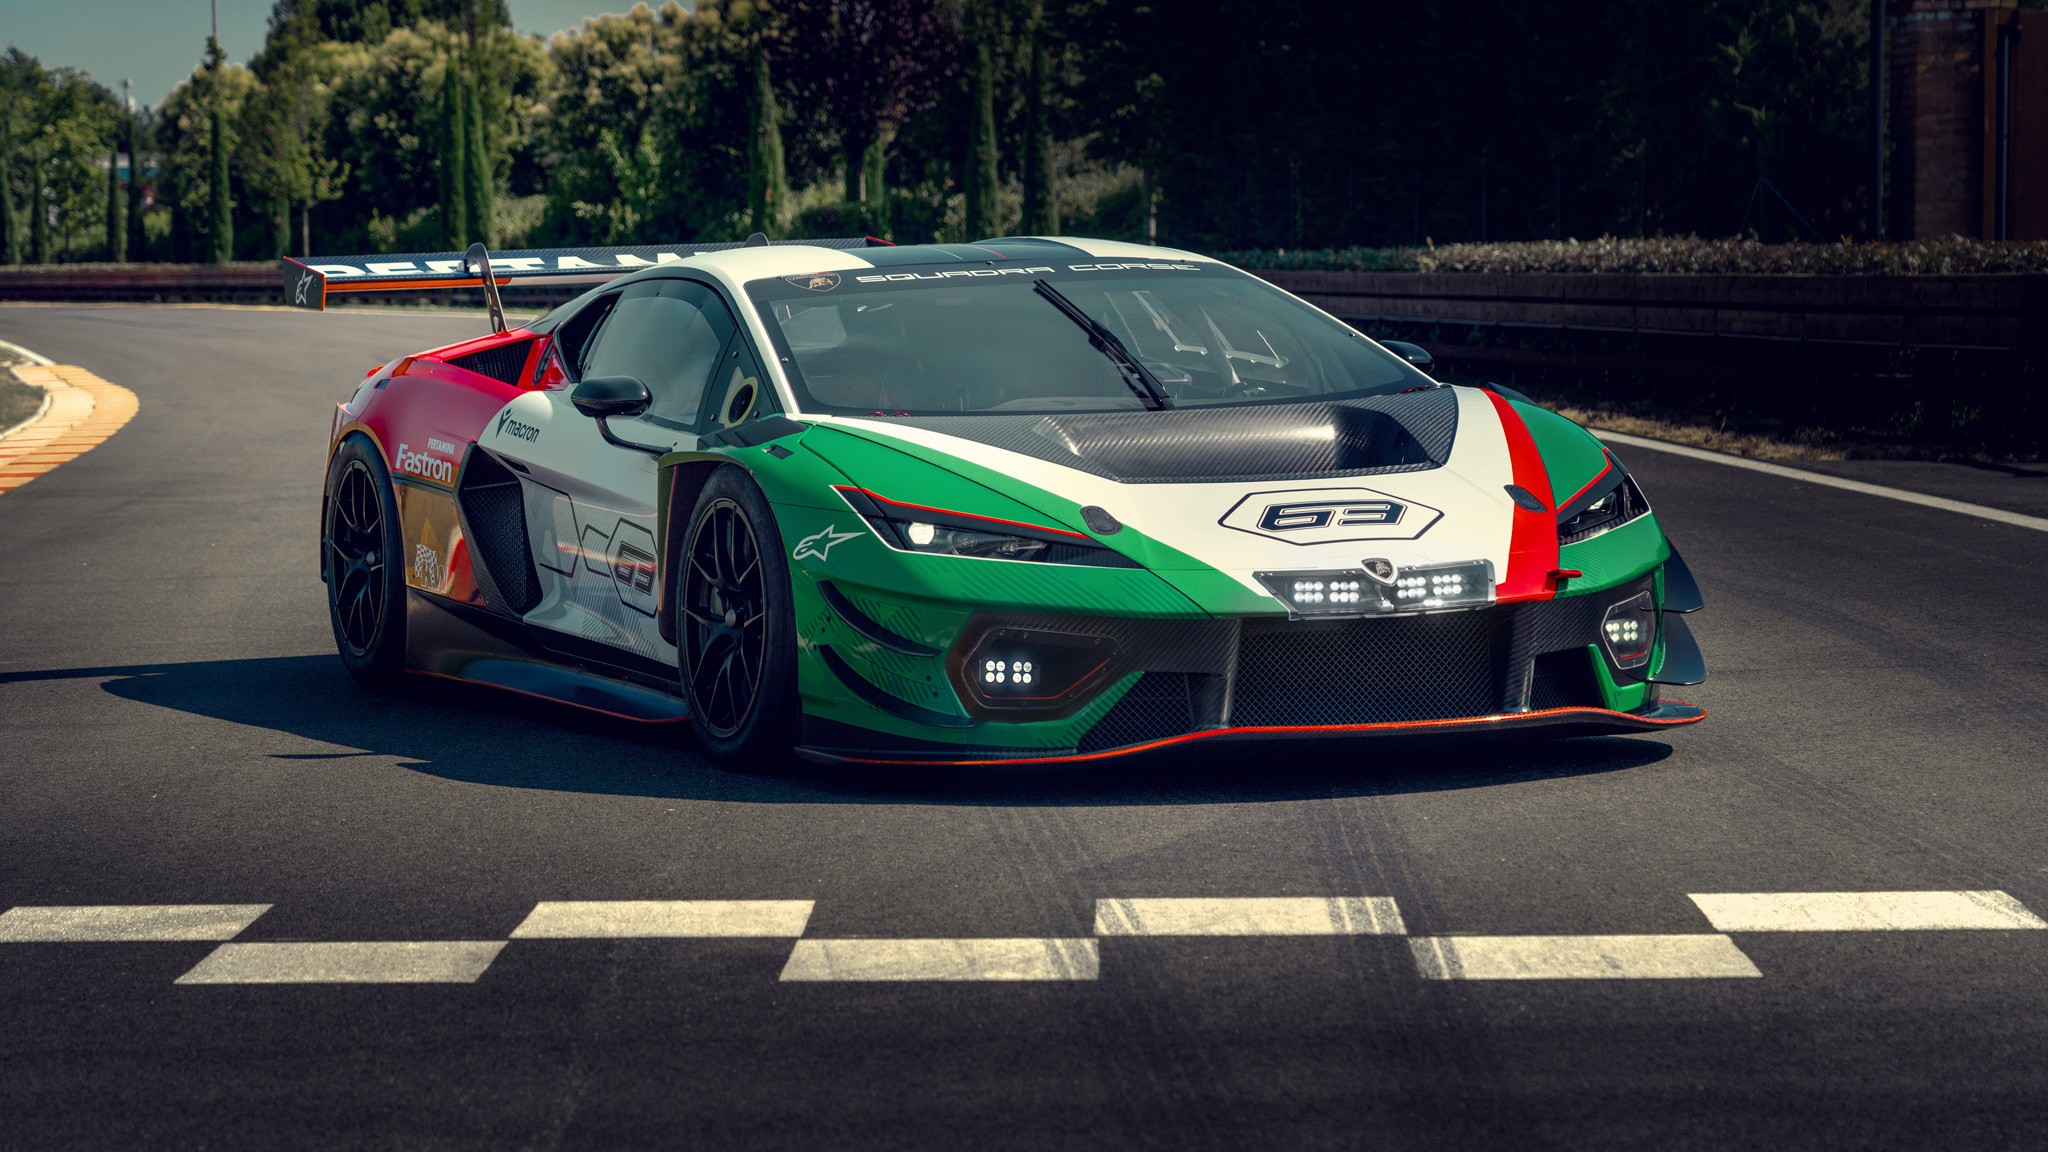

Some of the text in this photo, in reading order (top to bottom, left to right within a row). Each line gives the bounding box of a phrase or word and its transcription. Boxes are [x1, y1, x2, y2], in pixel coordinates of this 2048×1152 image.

[855, 263, 1201, 283] SQUADRA CORSE
[505, 419, 540, 443] macron
[428, 438, 455, 455] PERTAMINA
[395, 443, 453, 483] Fastron
[1256, 499, 1408, 532] 63
